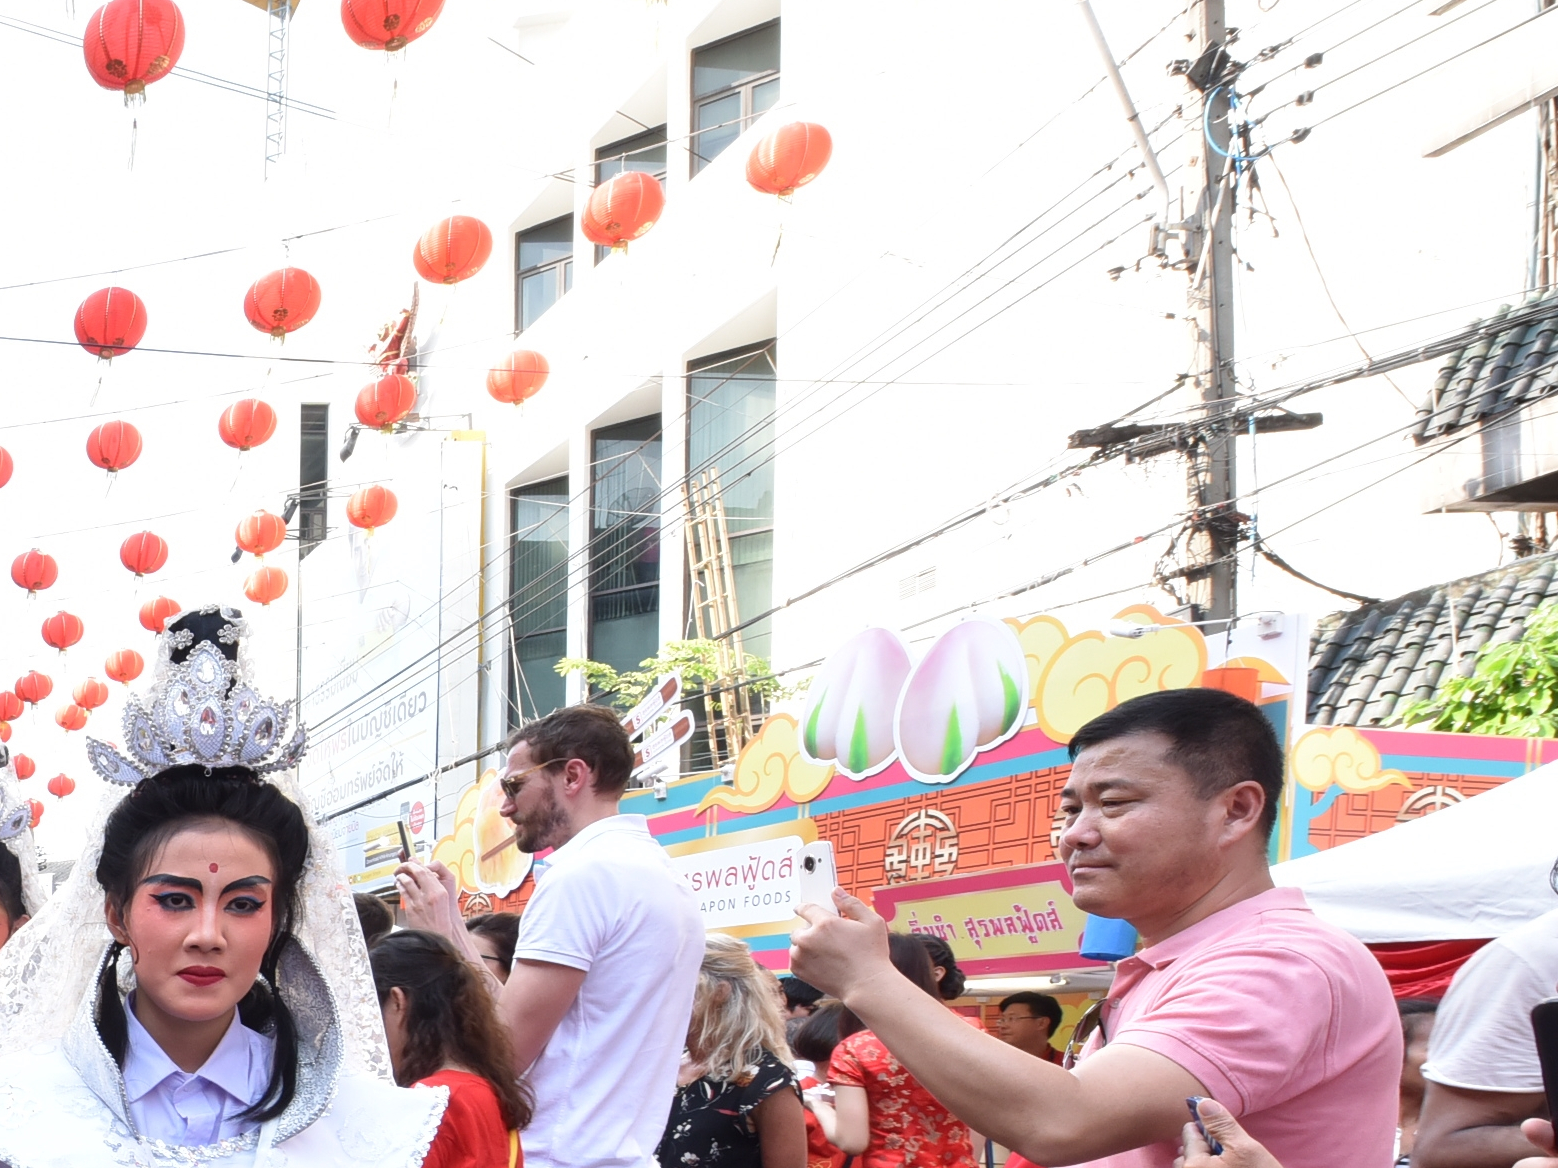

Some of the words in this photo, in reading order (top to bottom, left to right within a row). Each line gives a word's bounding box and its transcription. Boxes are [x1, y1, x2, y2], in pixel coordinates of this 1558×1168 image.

[700, 897, 736, 913] APON
[743, 890, 792, 908] FOODS
[964, 900, 1064, 950] สุรพลฟู้ดส์
